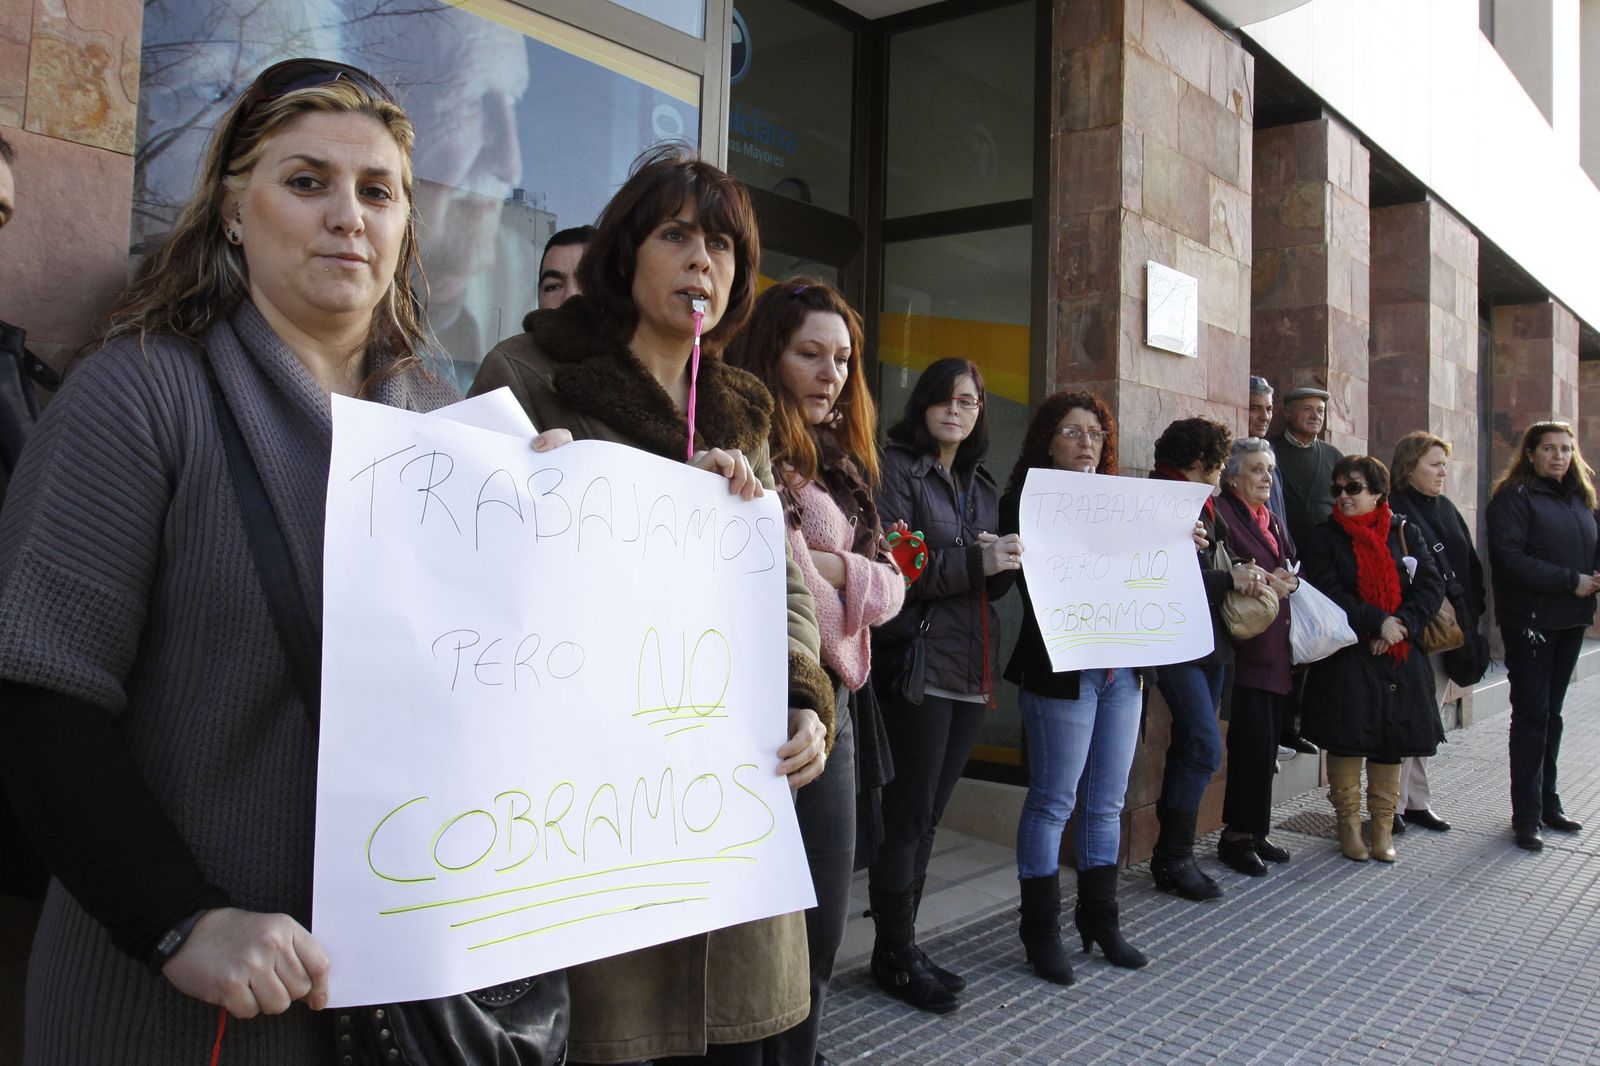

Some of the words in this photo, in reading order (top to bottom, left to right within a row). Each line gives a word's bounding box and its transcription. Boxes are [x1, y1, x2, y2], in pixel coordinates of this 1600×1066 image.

[743, 143, 784, 168] Mayores
[350, 445, 776, 575] TRABAJAMOS
[1046, 553, 1110, 583] PERO
[1129, 550, 1168, 582] NO
[432, 629, 585, 691] PERO
[637, 627, 731, 716] NO
[367, 764, 775, 883] COBRAMOS
